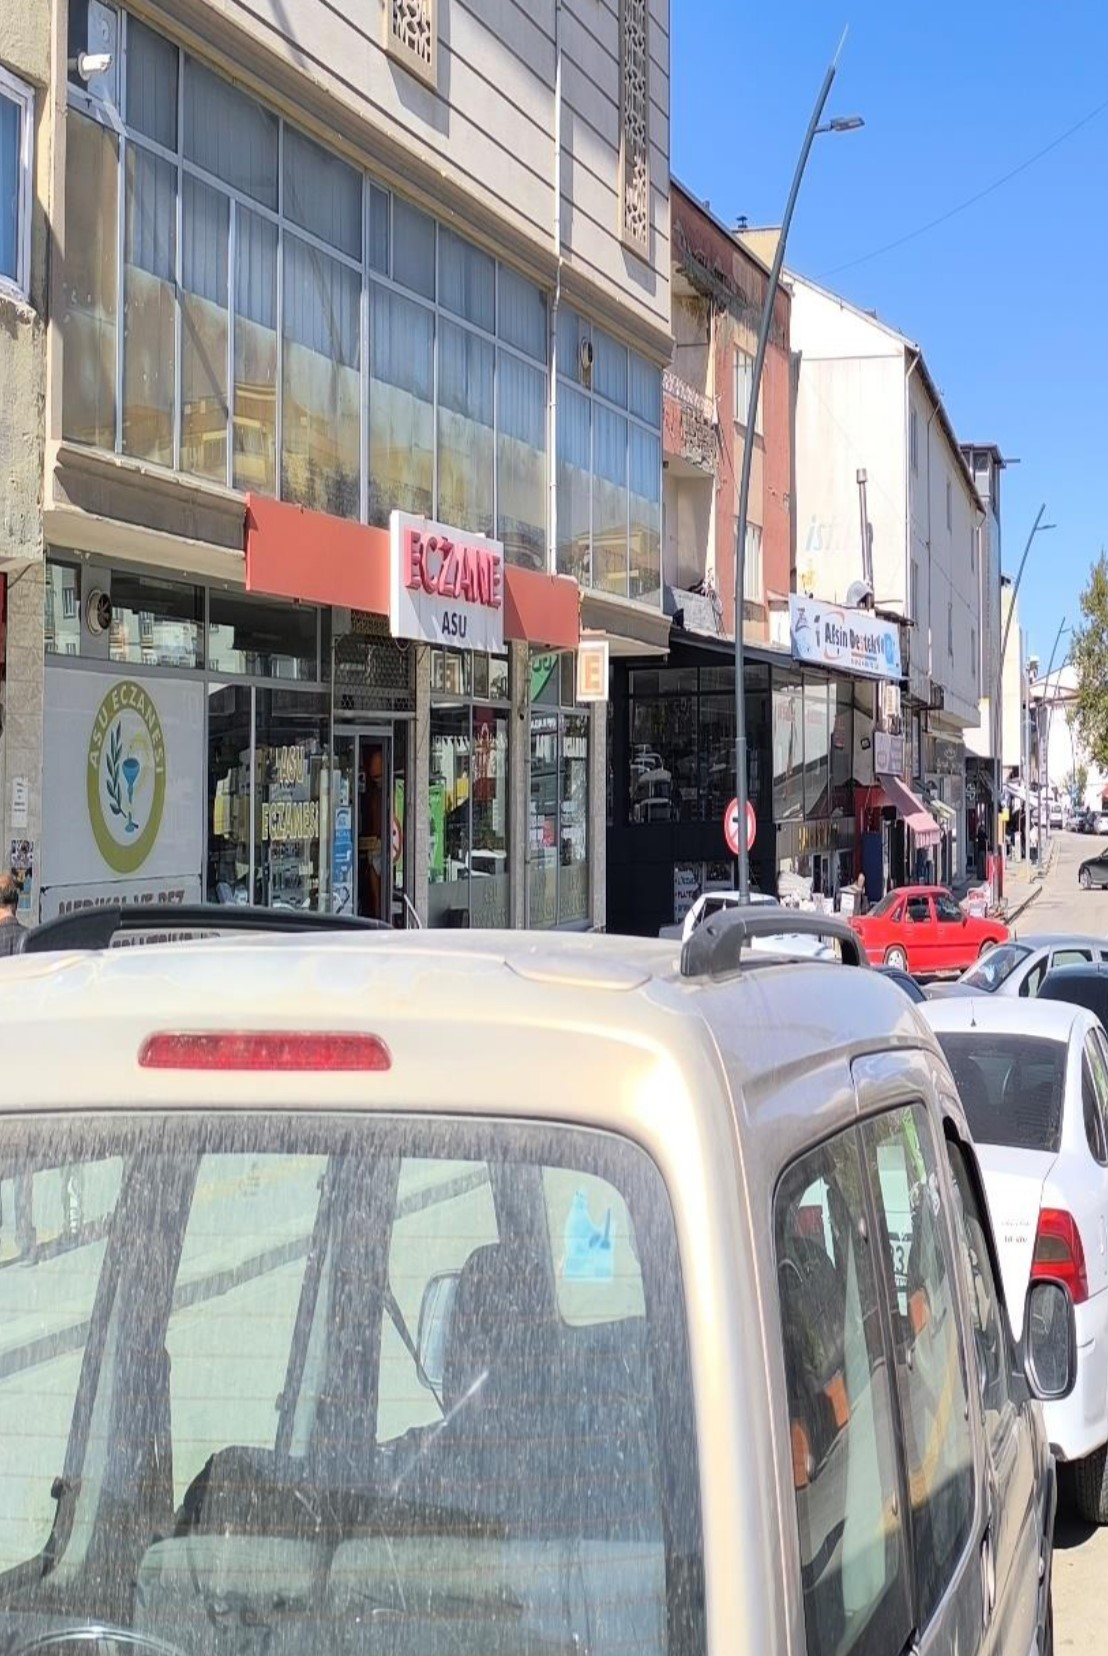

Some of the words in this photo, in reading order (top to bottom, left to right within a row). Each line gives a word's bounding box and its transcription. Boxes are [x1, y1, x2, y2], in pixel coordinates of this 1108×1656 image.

[405, 529, 502, 609] ECZANE
[441, 611, 467, 637] ASU
[89, 710, 108, 769] ASU
